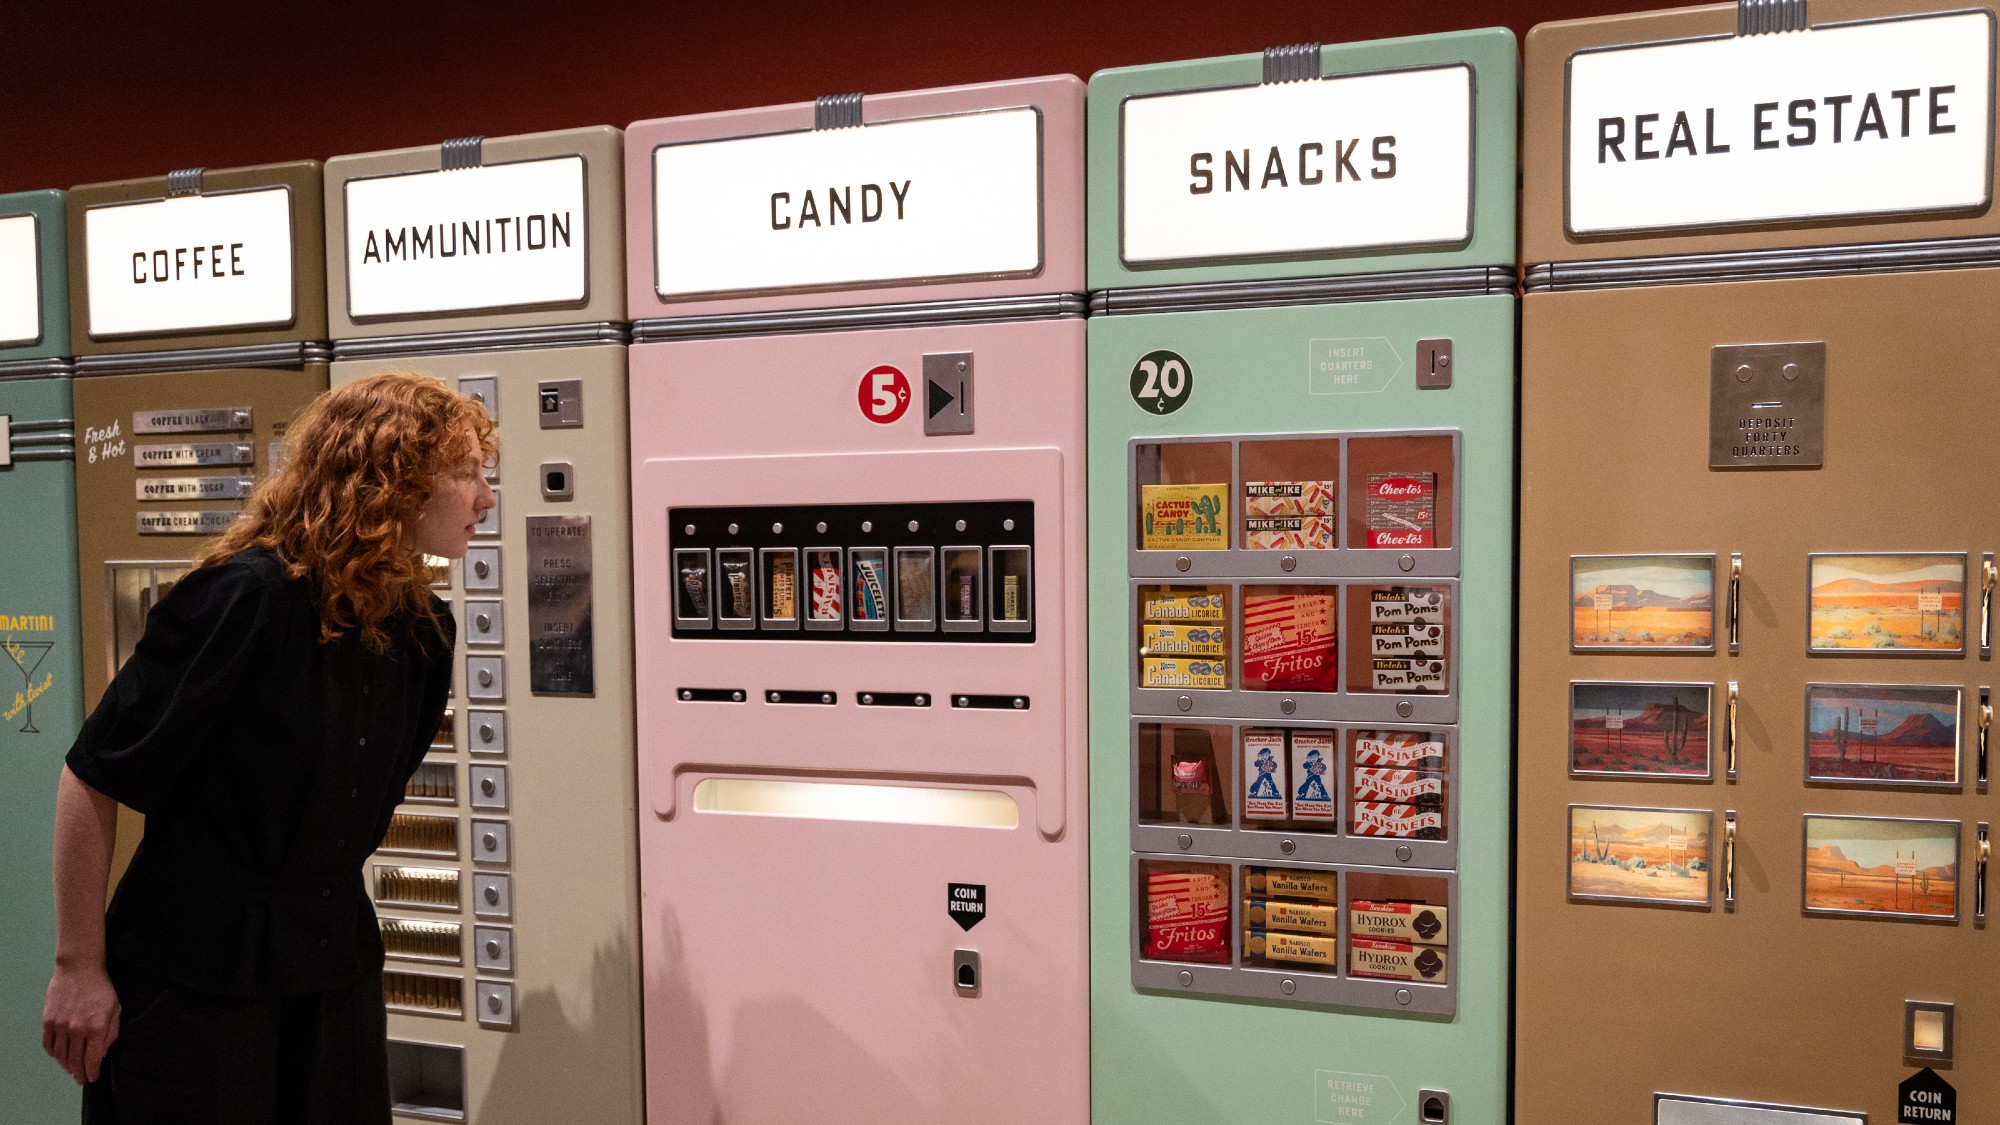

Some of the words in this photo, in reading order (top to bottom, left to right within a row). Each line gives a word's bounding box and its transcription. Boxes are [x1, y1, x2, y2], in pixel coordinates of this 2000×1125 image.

[1598, 108, 1730, 164] REAL
[1753, 85, 1956, 150] ESTATE
[1190, 135, 1397, 195] SNACKS
[771, 180, 912, 230] CANDY
[363, 212, 571, 265] AMMUNITION
[132, 243, 245, 283] COFFEE
[1328, 347, 1365, 358] INSERT
[1320, 360, 1374, 372] QUARTERS
[1137, 360, 1186, 398] 20
[1333, 374, 1360, 385] HERE
[151, 416, 183, 426] COFFEE
[184, 414, 209, 424] BLACK
[1739, 418, 1795, 430] DEPOSIT
[84, 419, 121, 445] Fresh
[1745, 432, 1788, 444] FORTY
[88, 449, 98, 464] &
[101, 441, 126, 461] Hot
[142, 450, 173, 460] COFFEE
[175, 449, 194, 459] WITH
[196, 448, 221, 458] CREAM
[1732, 445, 1801, 458] QUARTERS
[144, 484, 175, 494] COFFEE
[178, 483, 196, 493] WITH
[199, 482, 224, 493] SUGAR
[1248, 486, 1275, 494] MIKE
[1284, 486, 1300, 494] IKE
[1156, 500, 1190, 509] CACTUS
[1157, 509, 1189, 518] CANDY
[141, 517, 172, 526] COFFEE
[173, 516, 199, 527] CREAM
[1248, 520, 1275, 528] MIKE
[1284, 520, 1300, 528] IKE
[531, 527, 542, 537] TO
[543, 558, 572, 569] PRESS
[860, 563, 886, 619] JUICELETS
[1375, 593, 1405, 601] Welch's
[1147, 600, 1190, 618] Canada
[1191, 609, 1219, 618] LICORICE
[1376, 605, 1402, 618] Pom
[1404, 603, 1439, 616] Poms
[1375, 626, 1406, 634] Welch's
[1147, 632, 1190, 653] Canada
[1191, 644, 1220, 653] LICORICE
[1376, 638, 1402, 650] Pom
[1404, 636, 1439, 648] Poms
[1261, 655, 1323, 682] Fritos
[1376, 661, 1408, 669] Welch's
[1148, 666, 1191, 685] Canada
[1192, 677, 1222, 686] LICORICE
[1377, 673, 1403, 685] Pom
[1405, 671, 1441, 683] Poms
[1363, 741, 1437, 761] RAISINETS
[1361, 777, 1436, 797] RAISINETS
[1361, 812, 1436, 832] RAISINETS
[1272, 880, 1298, 890] Vanilla
[1300, 882, 1328, 892] Wafers
[953, 888, 977, 900] COIN
[950, 901, 984, 913] RETURN
[1271, 914, 1297, 924] Vanilla
[1300, 917, 1327, 927] Wafers
[1357, 914, 1407, 928] HYDROX
[1157, 926, 1216, 950] Fritos
[1271, 944, 1297, 955] Vanilla
[1300, 947, 1327, 958] Wafers
[1358, 950, 1408, 966] HYDROX
[1369, 964, 1396, 972] COOKIES
[1327, 1079, 1375, 1093] RETRIEVE
[1330, 1093, 1371, 1106] CHANGE
[1909, 1090, 1942, 1104] COIN
[1338, 1107, 1365, 1118] HERE
[1903, 1104, 1952, 1121] RETURN
